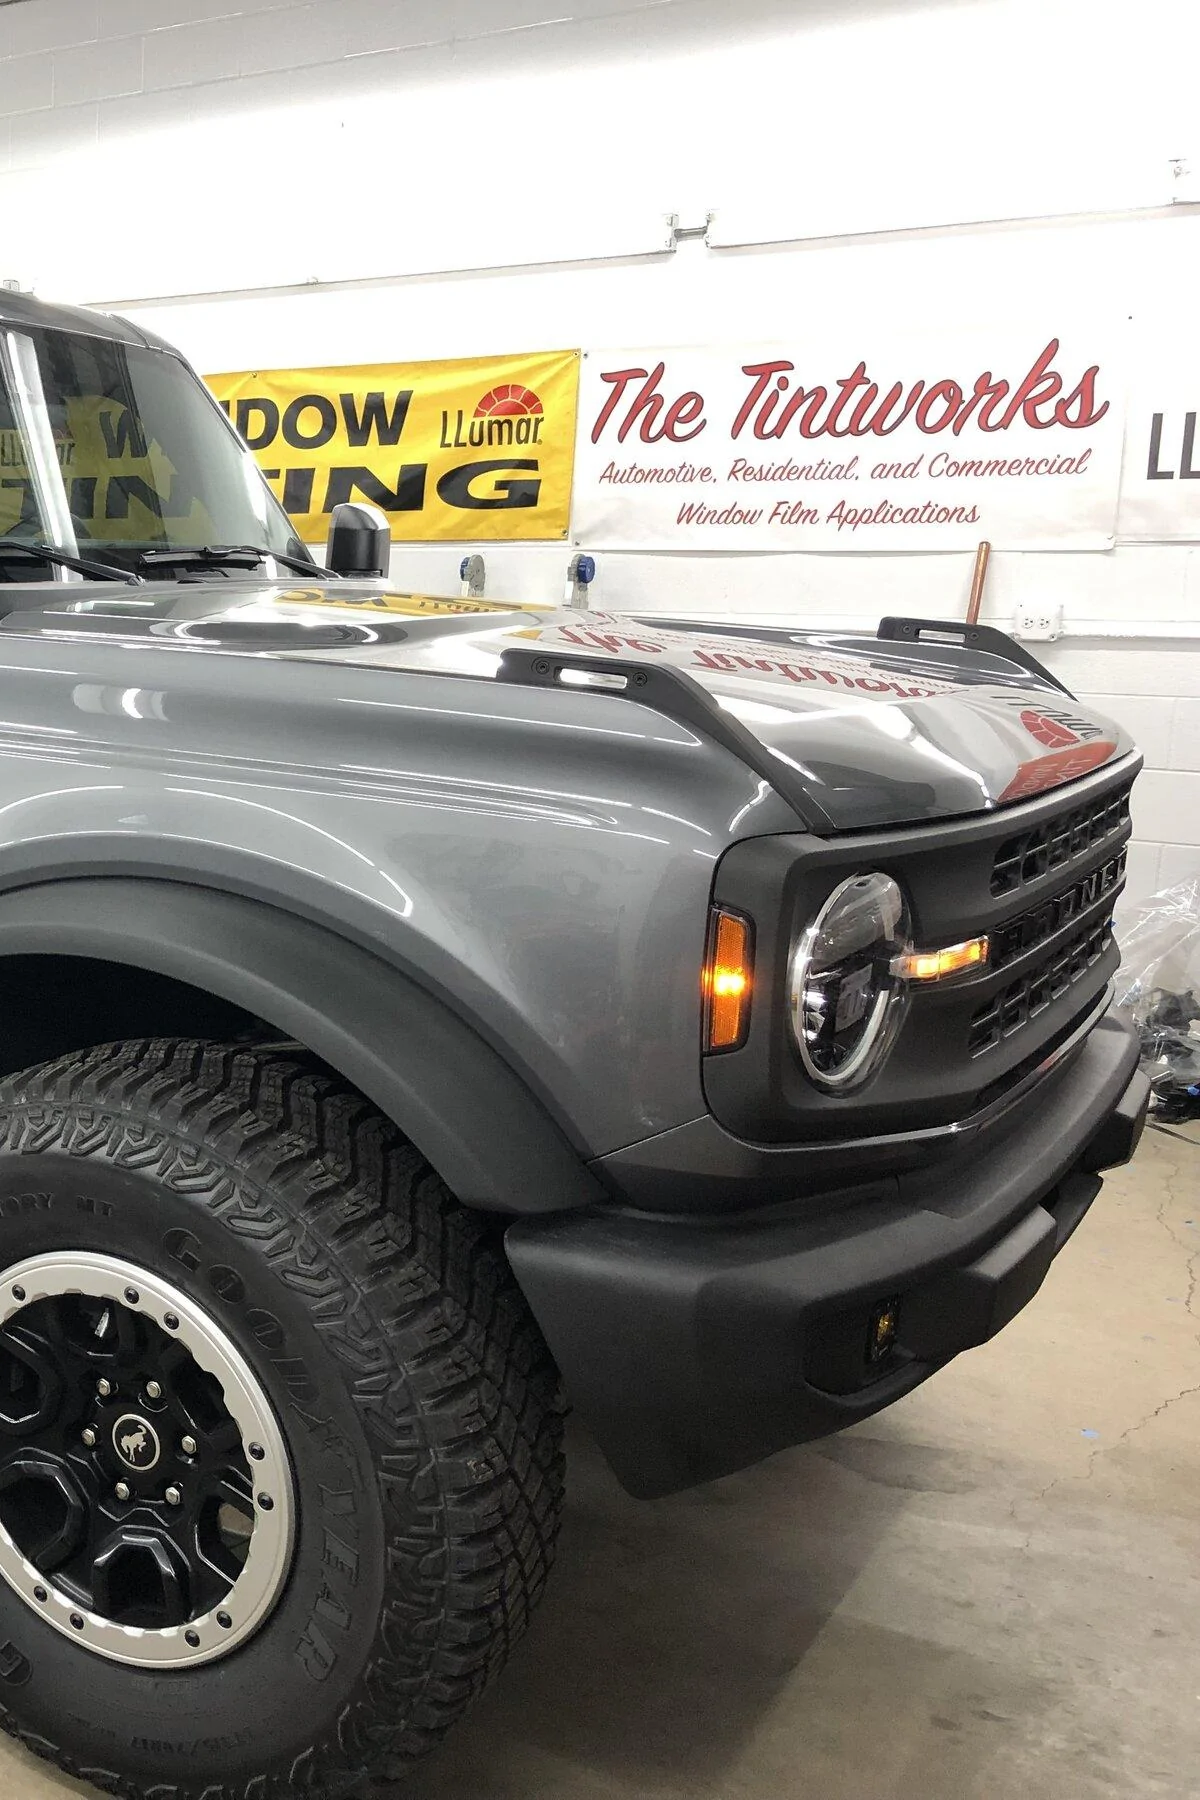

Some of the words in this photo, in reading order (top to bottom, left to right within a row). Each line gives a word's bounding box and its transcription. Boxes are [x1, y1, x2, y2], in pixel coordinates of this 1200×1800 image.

[591, 361, 707, 444] The
[731, 337, 1110, 441] Tintworks
[440, 408, 543, 449] LLumar
[599, 460, 717, 485] Automotive,
[727, 455, 860, 482] Residential,
[870, 453, 925, 480] and
[928, 447, 1093, 478] Commercial
[676, 501, 764, 525] Window
[767, 500, 820, 525] Film
[825, 499, 981, 532] Applications
